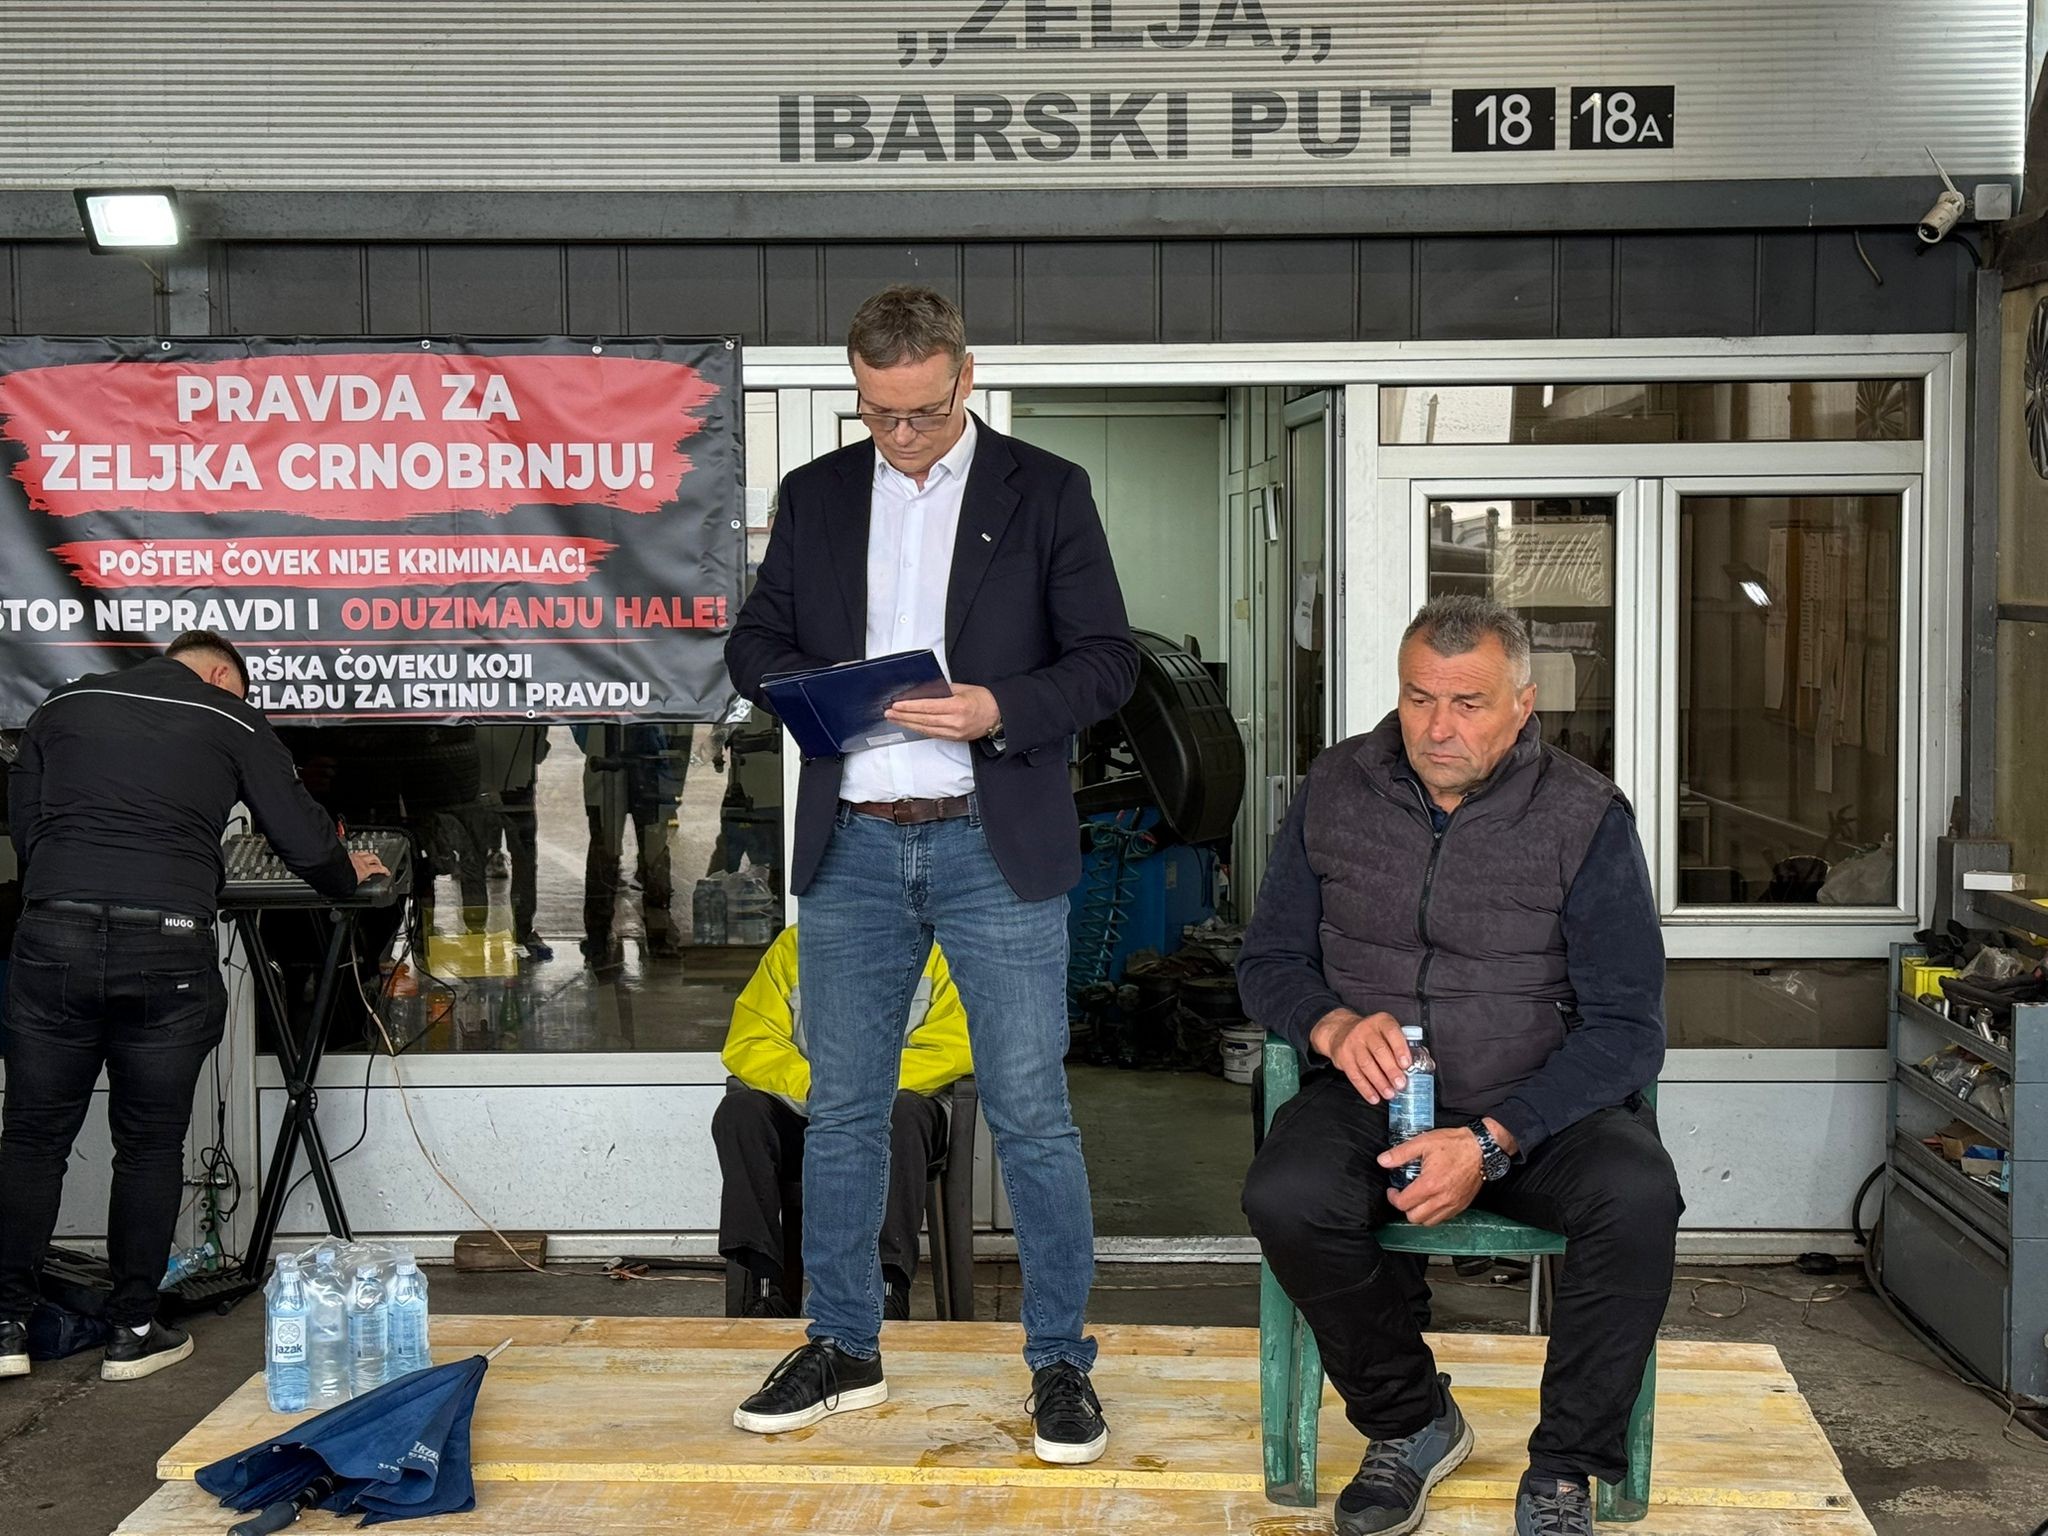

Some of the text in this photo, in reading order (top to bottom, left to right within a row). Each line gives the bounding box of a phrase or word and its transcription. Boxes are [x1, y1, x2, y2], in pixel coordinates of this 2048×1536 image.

[779, 90, 1431, 162] IBARSKI PUT
[1476, 94, 1532, 145] 18
[1580, 92, 1664, 144] 18A
[176, 375, 520, 422] PRAVDA ZA
[41, 431, 655, 490] ŽELJKA CRNOBRNJU!
[99, 542, 587, 576] POŠTEN ČOVEK NIJE KRIMINALAC!
[0, 596, 729, 632] TOP NEPRAVDI I ODUZIMANJU HALE!
[245, 648, 533, 682] RŠKA ČOVEKU KOJI
[354, 683, 397, 709] ZA
[403, 682, 501, 709] ISTINU
[508, 682, 517, 708] I
[527, 682, 651, 708] PRAVDU
[165, 917, 194, 928] HUGO
[275, 1343, 303, 1356] jazak
